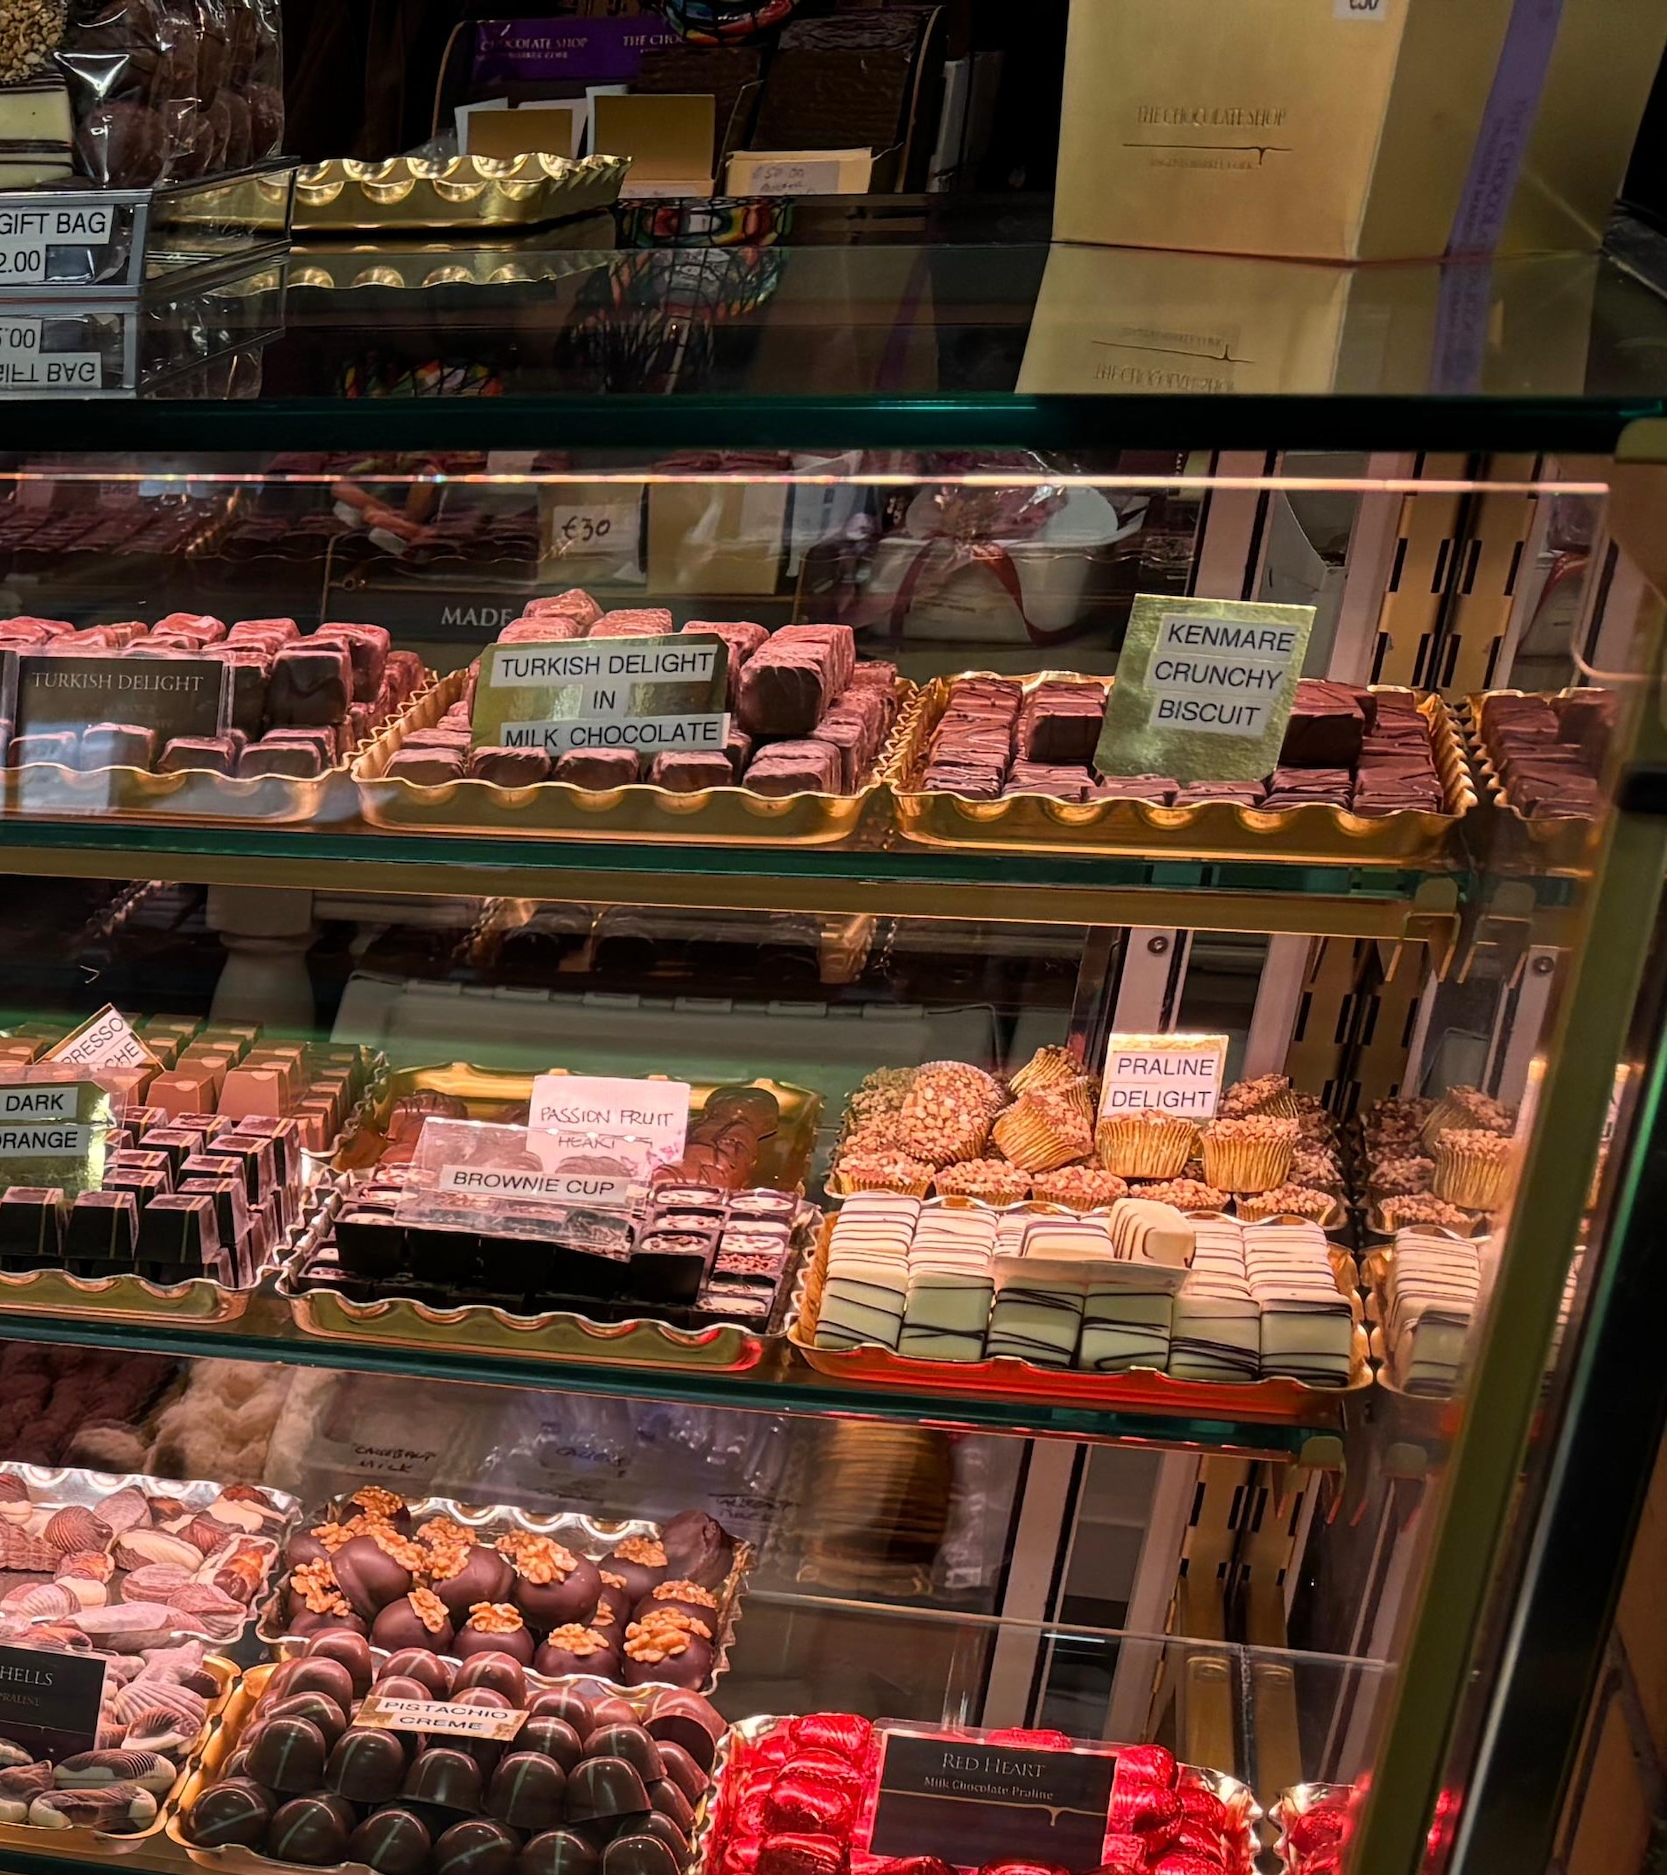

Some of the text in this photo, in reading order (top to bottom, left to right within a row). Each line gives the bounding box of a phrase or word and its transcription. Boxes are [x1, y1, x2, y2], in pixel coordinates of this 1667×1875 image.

[56, 211, 106, 234] BAG
[561, 516, 612, 542] €30
[441, 605, 514, 628] MADE
[1167, 623, 1295, 652] KENMARE
[502, 651, 713, 678] TURKISH DELIGHT
[1155, 660, 1283, 690] CRUNCHY
[31, 670, 204, 694] TURKISH DELIGHT
[593, 689, 616, 709] IN
[1157, 700, 1262, 728] BISCUIT
[506, 721, 718, 749] MILK CHOCOLATE
[1116, 1057, 1214, 1077] PRALINE
[5, 1093, 65, 1112] DARK
[1111, 1090, 1212, 1109] DELIGHT
[540, 1106, 674, 1128] PASSION FRUIT
[454, 1171, 615, 1197] BROWNIE CUP
[383, 1697, 510, 1721] PISTACHIO
